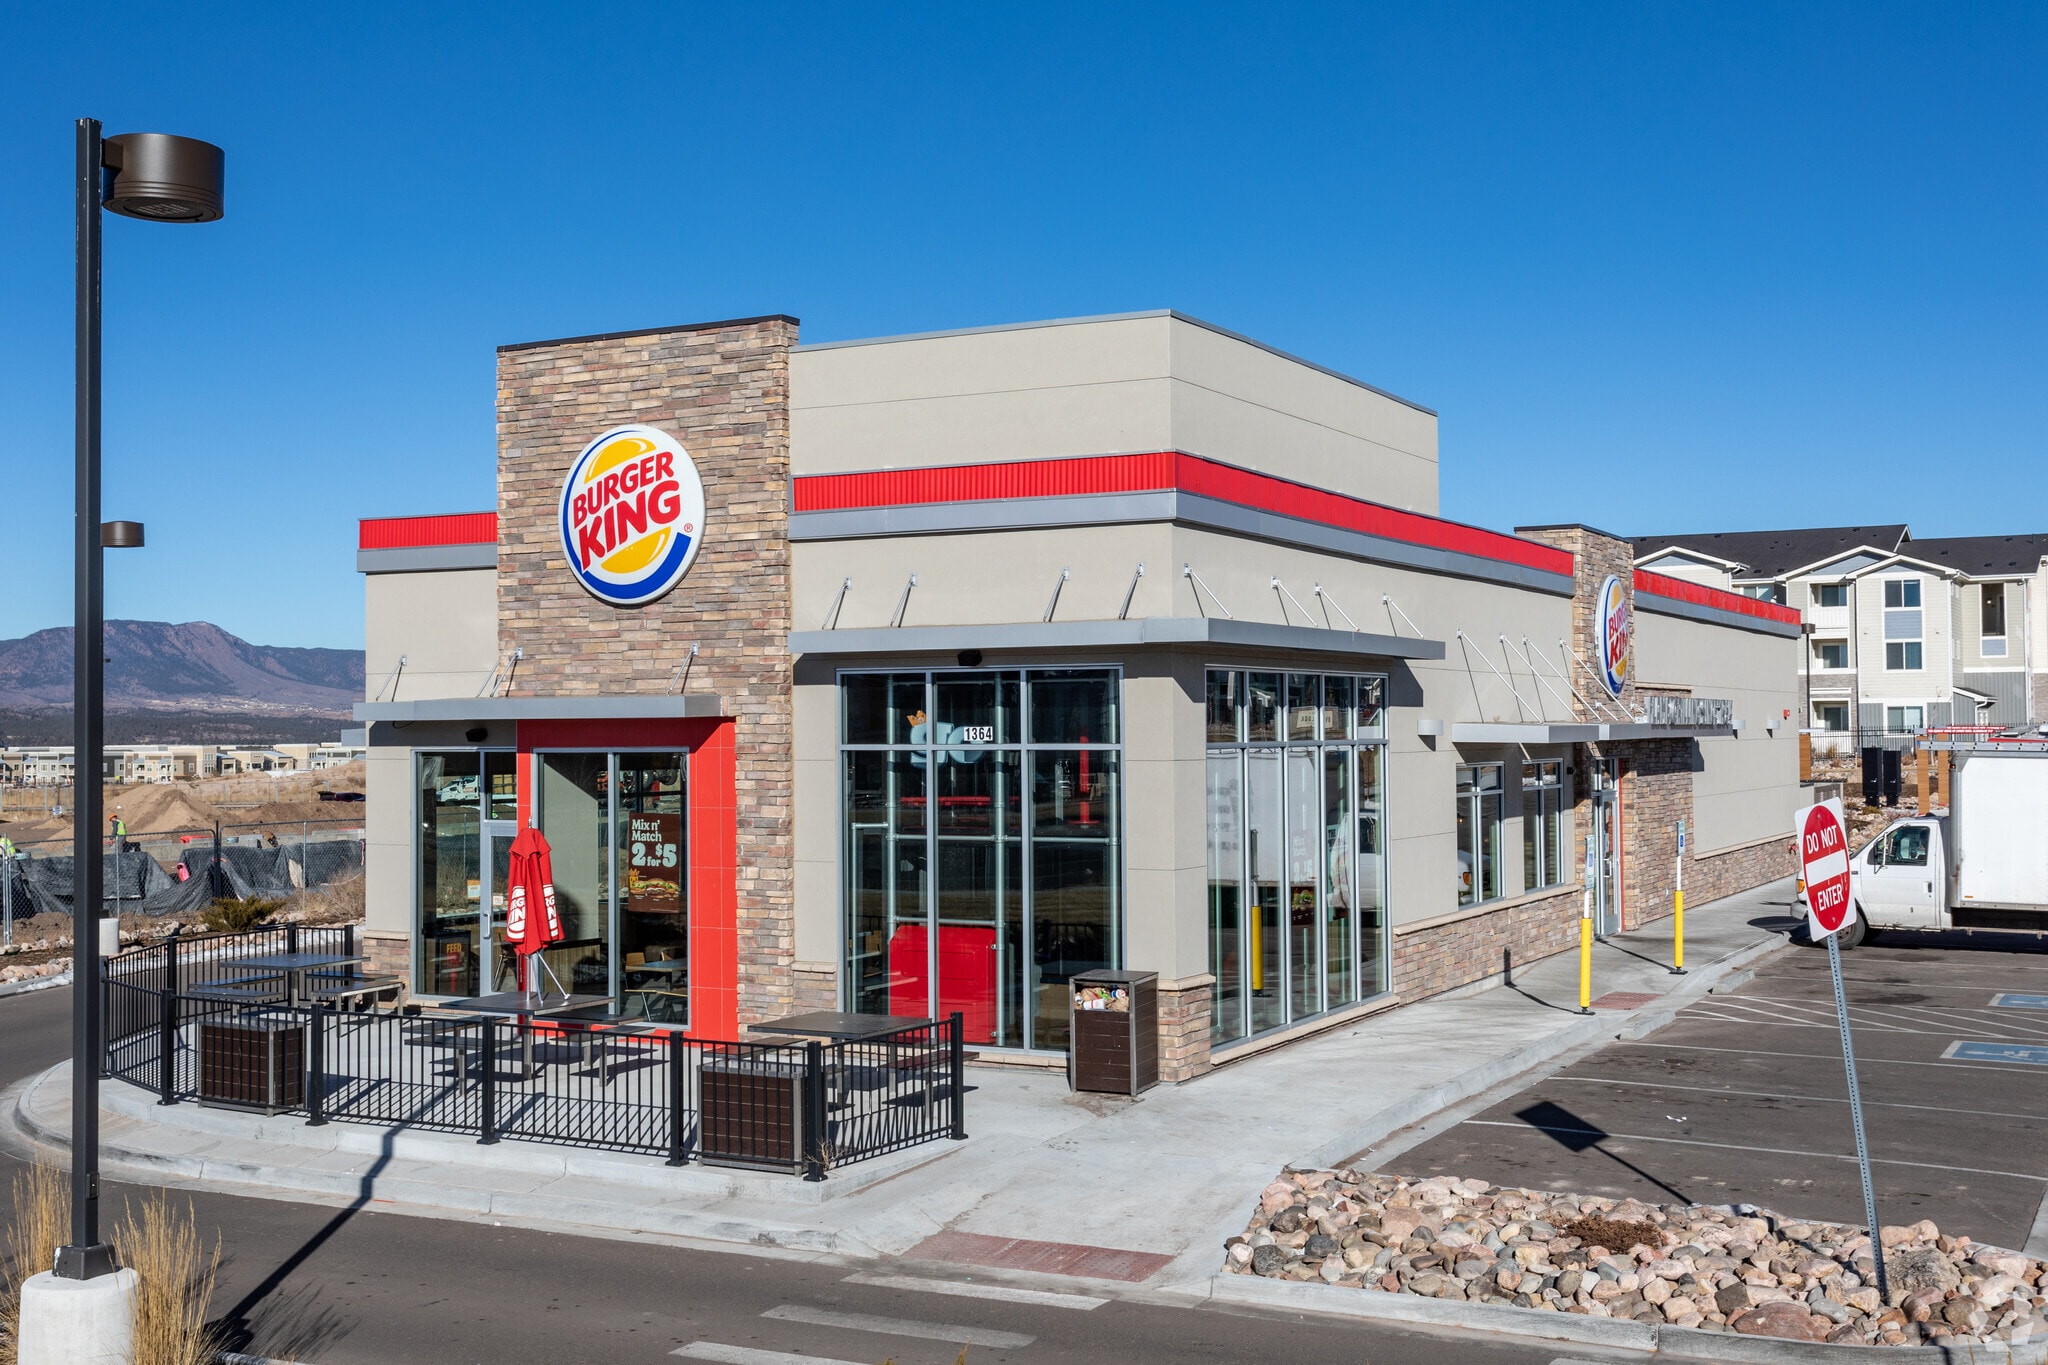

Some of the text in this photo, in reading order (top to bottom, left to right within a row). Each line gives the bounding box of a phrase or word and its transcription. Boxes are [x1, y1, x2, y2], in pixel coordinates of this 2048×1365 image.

[573, 451, 674, 529] BURGER
[579, 480, 681, 570] KING
[965, 727, 992, 741] 1364
[632, 819, 650, 831] Mix
[632, 831, 662, 842] Match
[1806, 825, 1838, 855] DO NOT
[632, 842, 646, 866] 2
[647, 856, 661, 867] for
[1817, 883, 1845, 912] ENTER
[446, 943, 462, 953] FEED
